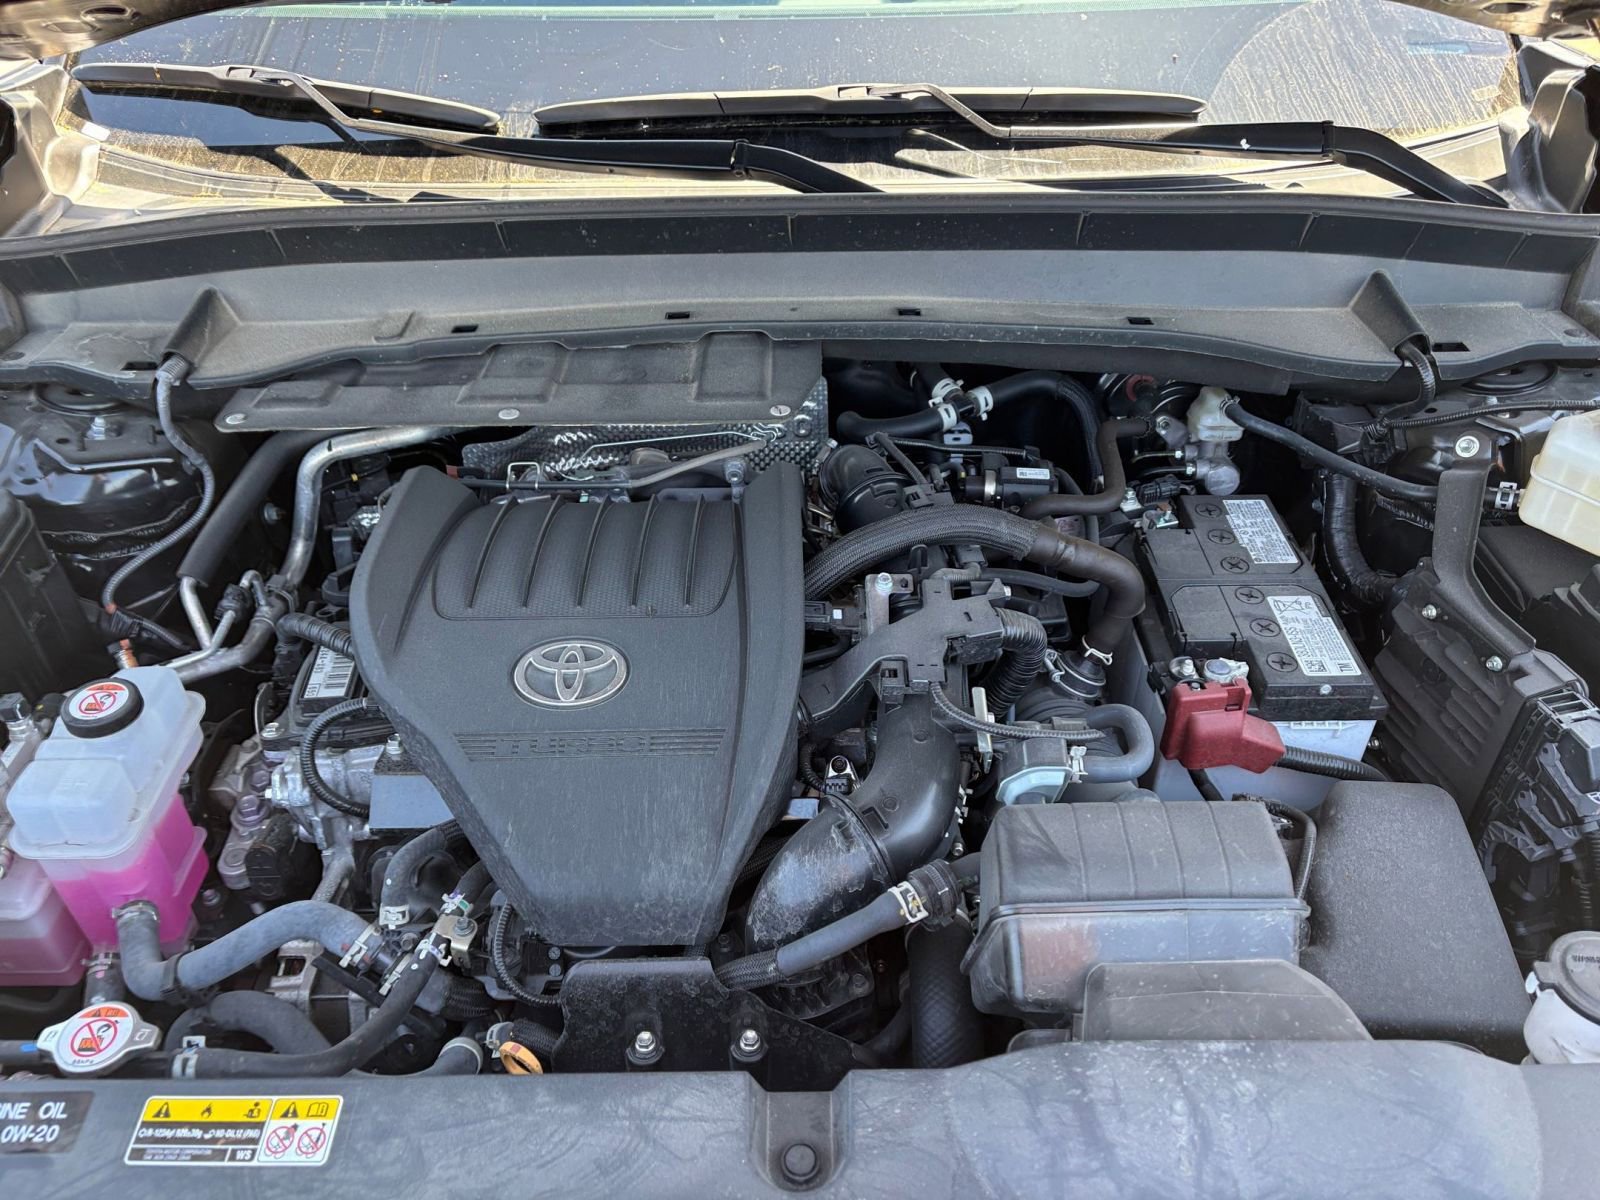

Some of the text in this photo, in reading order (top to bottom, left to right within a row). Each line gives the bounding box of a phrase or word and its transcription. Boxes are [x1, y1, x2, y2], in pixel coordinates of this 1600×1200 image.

[500, 736, 647, 753] TURBO
[0, 1101, 68, 1120] INE OIL
[0, 1124, 60, 1143] 0W-20
[235, 1150, 252, 1160] WS
